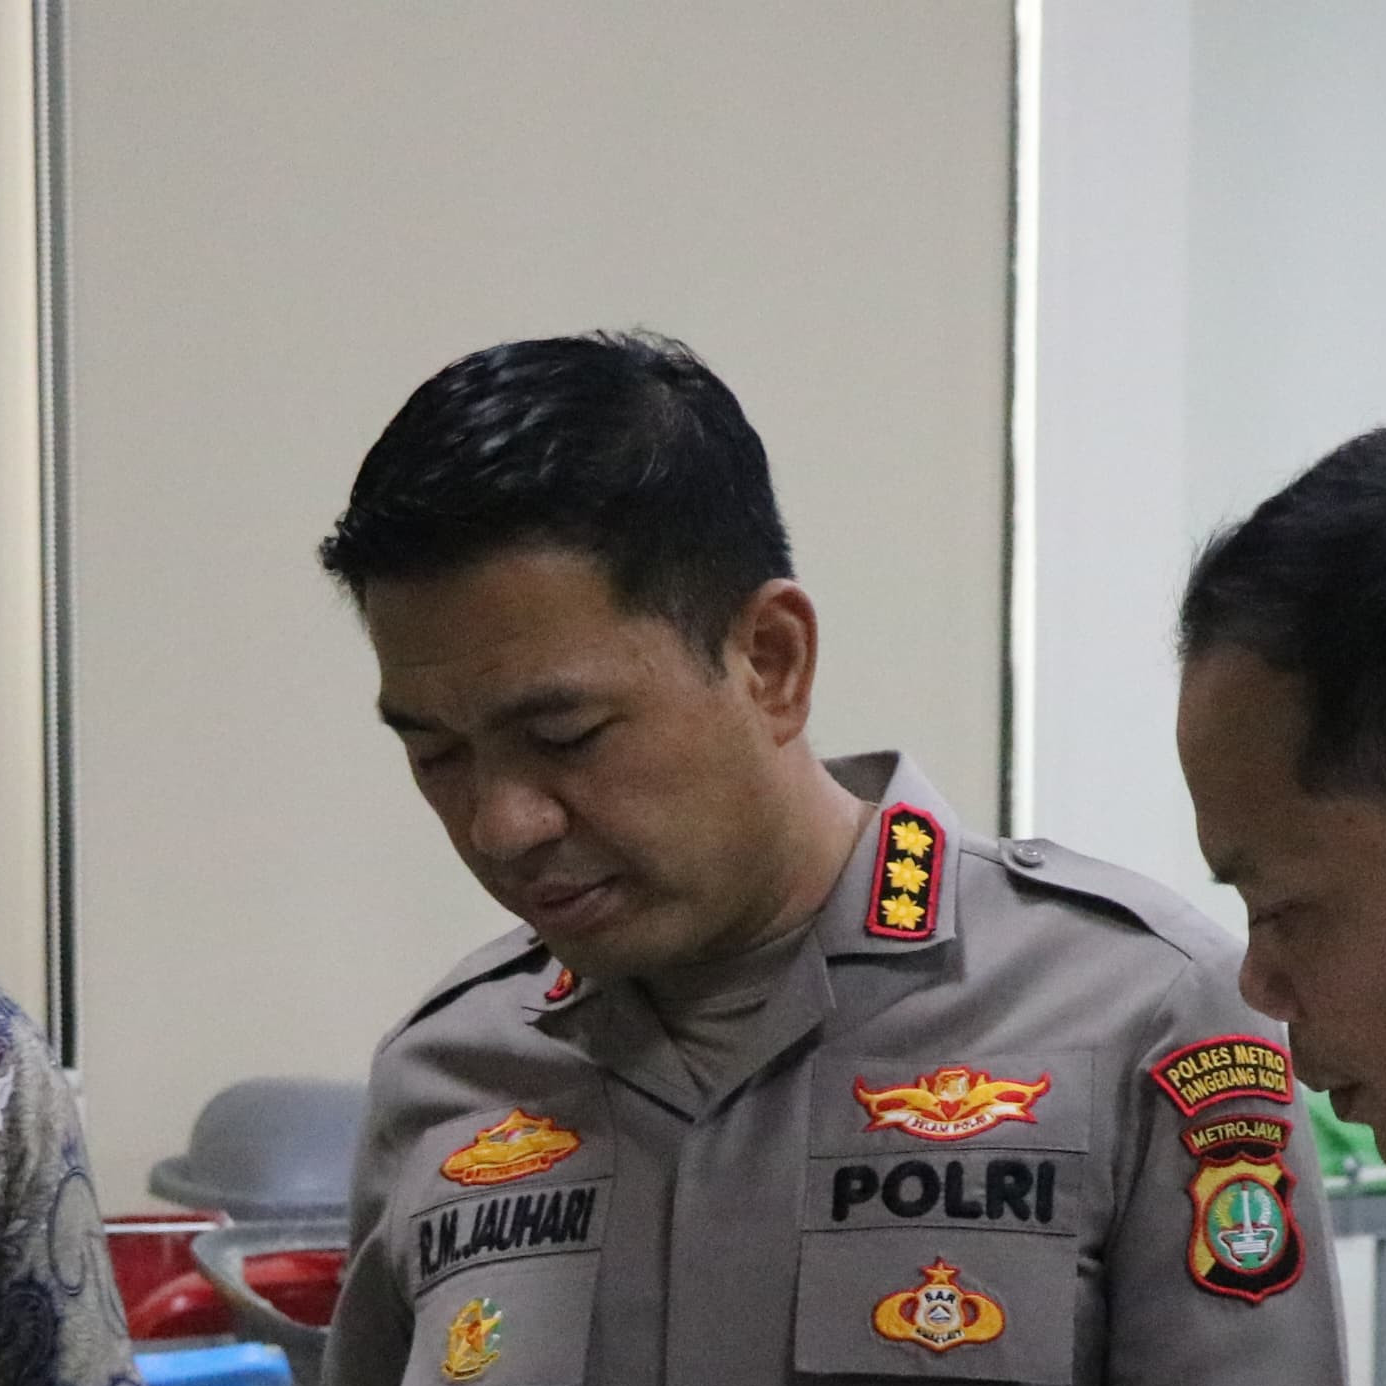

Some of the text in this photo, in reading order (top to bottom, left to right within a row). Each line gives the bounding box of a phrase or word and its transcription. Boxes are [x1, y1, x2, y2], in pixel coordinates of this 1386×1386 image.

[1166, 1044, 1286, 1088] POLRES METRO
[1179, 1067, 1287, 1105] TANGERANG KOTA
[831, 1159, 1057, 1225] POLRI
